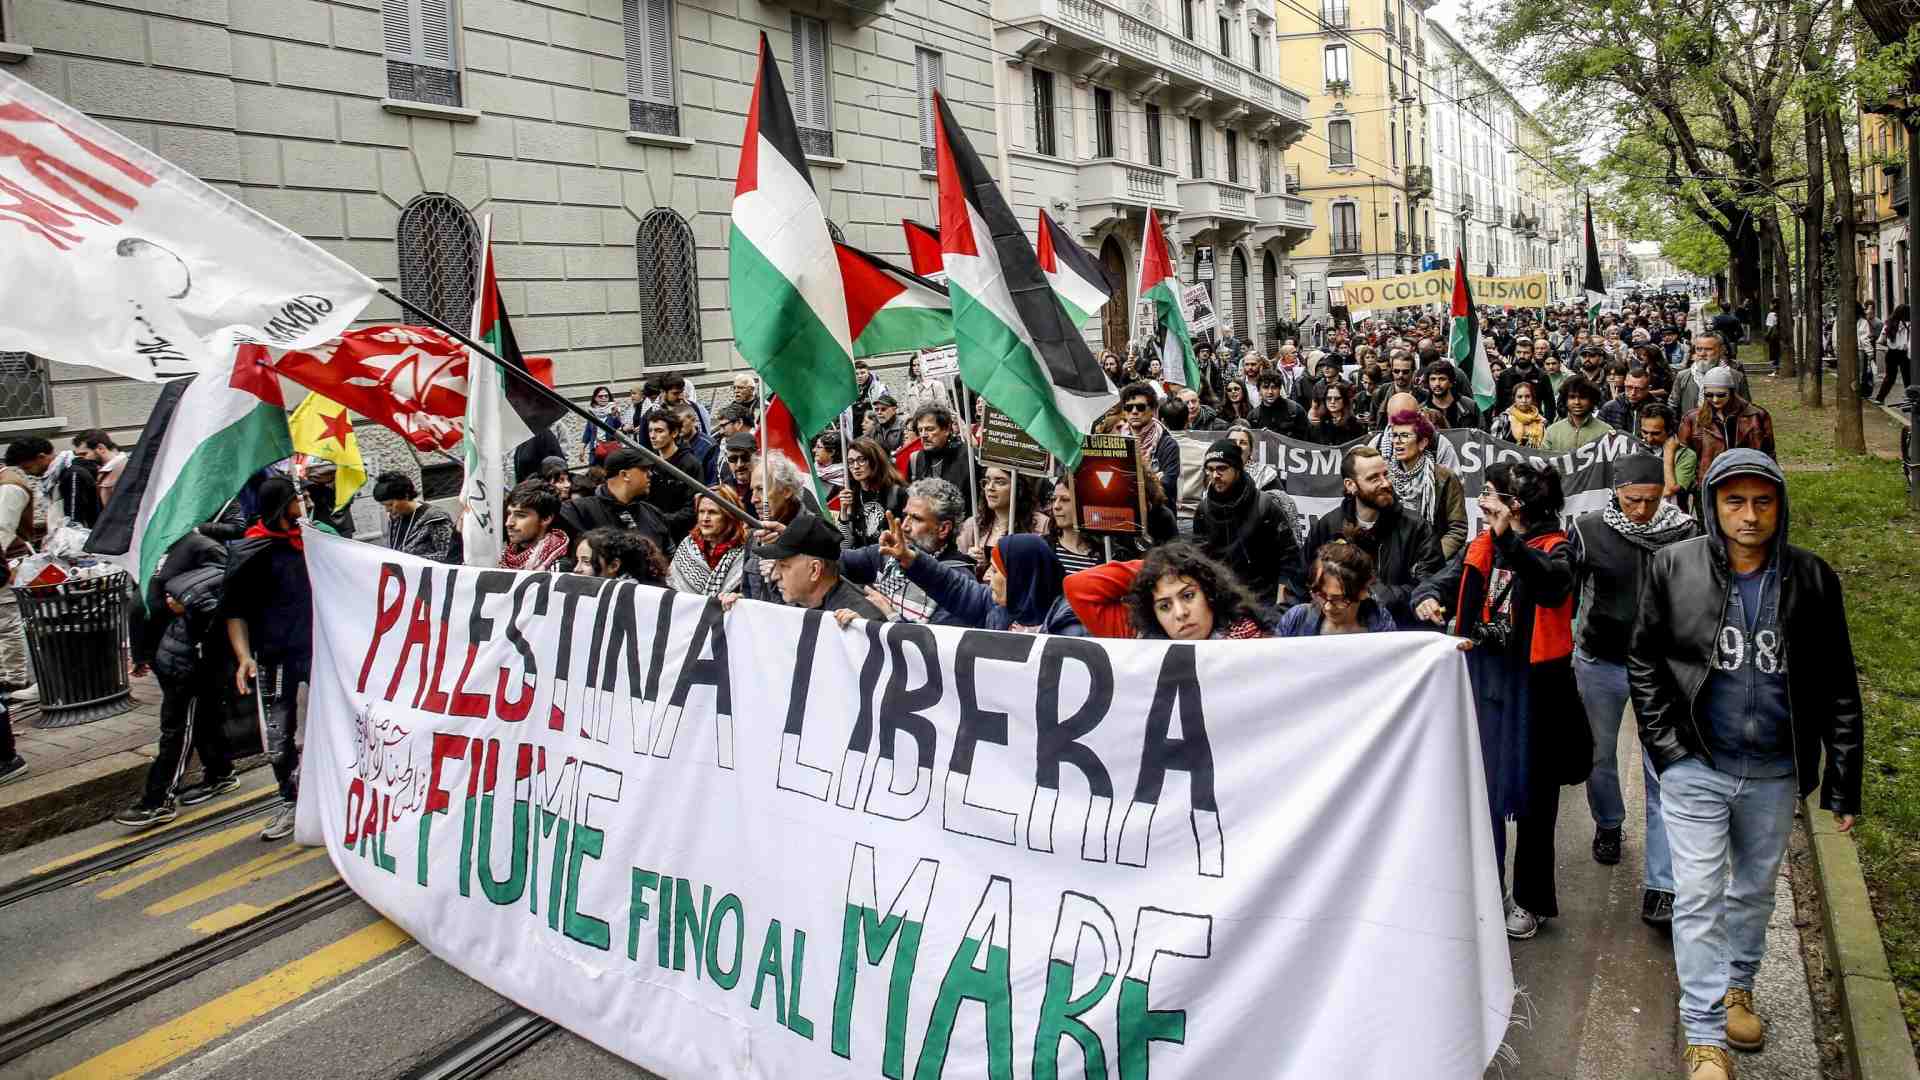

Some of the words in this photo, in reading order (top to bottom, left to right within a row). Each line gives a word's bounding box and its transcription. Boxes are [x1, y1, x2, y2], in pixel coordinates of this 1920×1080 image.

[1425, 255, 1433, 267] P
[1347, 286, 1375, 304] NO
[1382, 278, 1543, 301] COLONLISMO
[1090, 435, 1127, 449] GUERRA
[356, 562, 735, 770] PALESTINA
[776, 608, 1225, 878] LIBERA
[343, 777, 397, 873] DAL
[417, 732, 624, 951] FIUME
[627, 866, 746, 990] FINO
[751, 918, 815, 1041] AL
[831, 842, 1213, 1080] MARE
